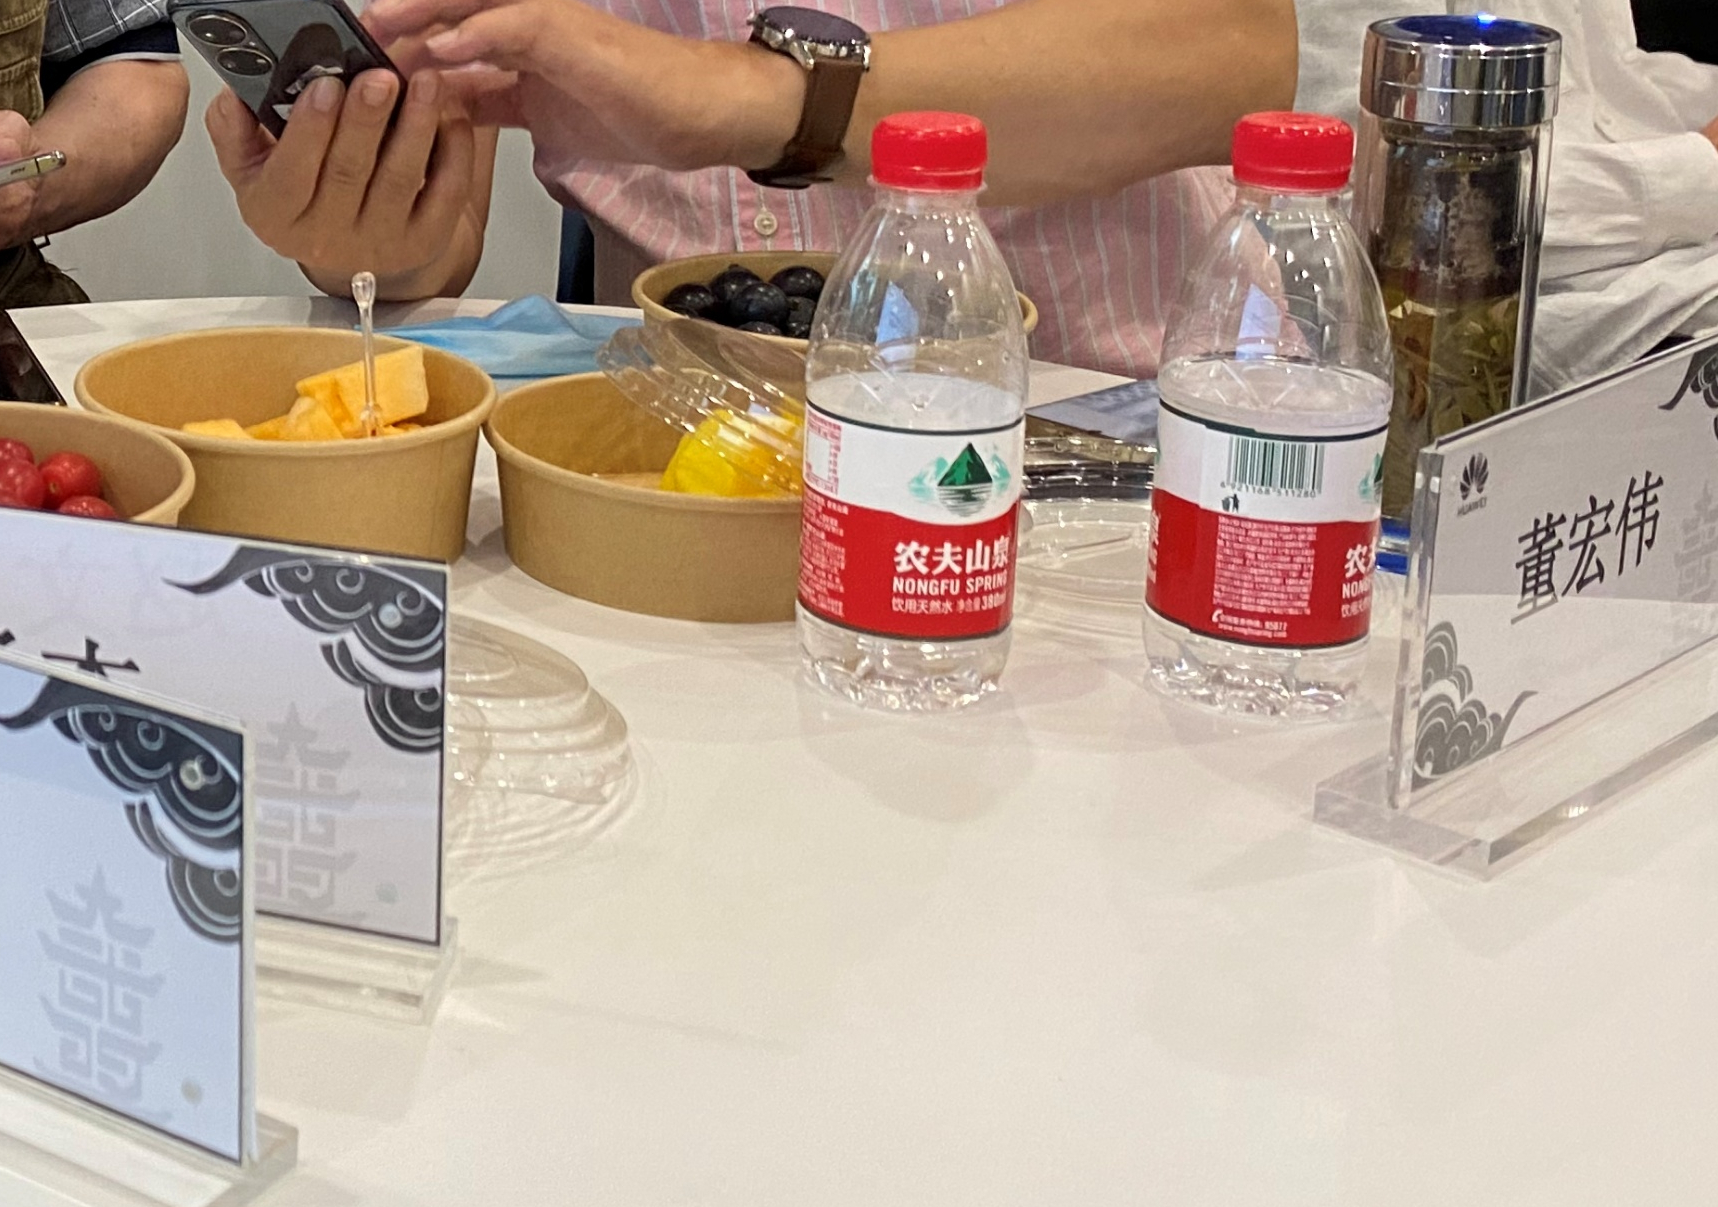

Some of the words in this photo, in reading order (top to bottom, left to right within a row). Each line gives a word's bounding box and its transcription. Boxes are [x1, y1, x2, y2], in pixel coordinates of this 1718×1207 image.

[893, 534, 1010, 576] 农夫山泉
[1511, 470, 1664, 625] 董宏伟
[892, 576, 961, 596] NONGFU
